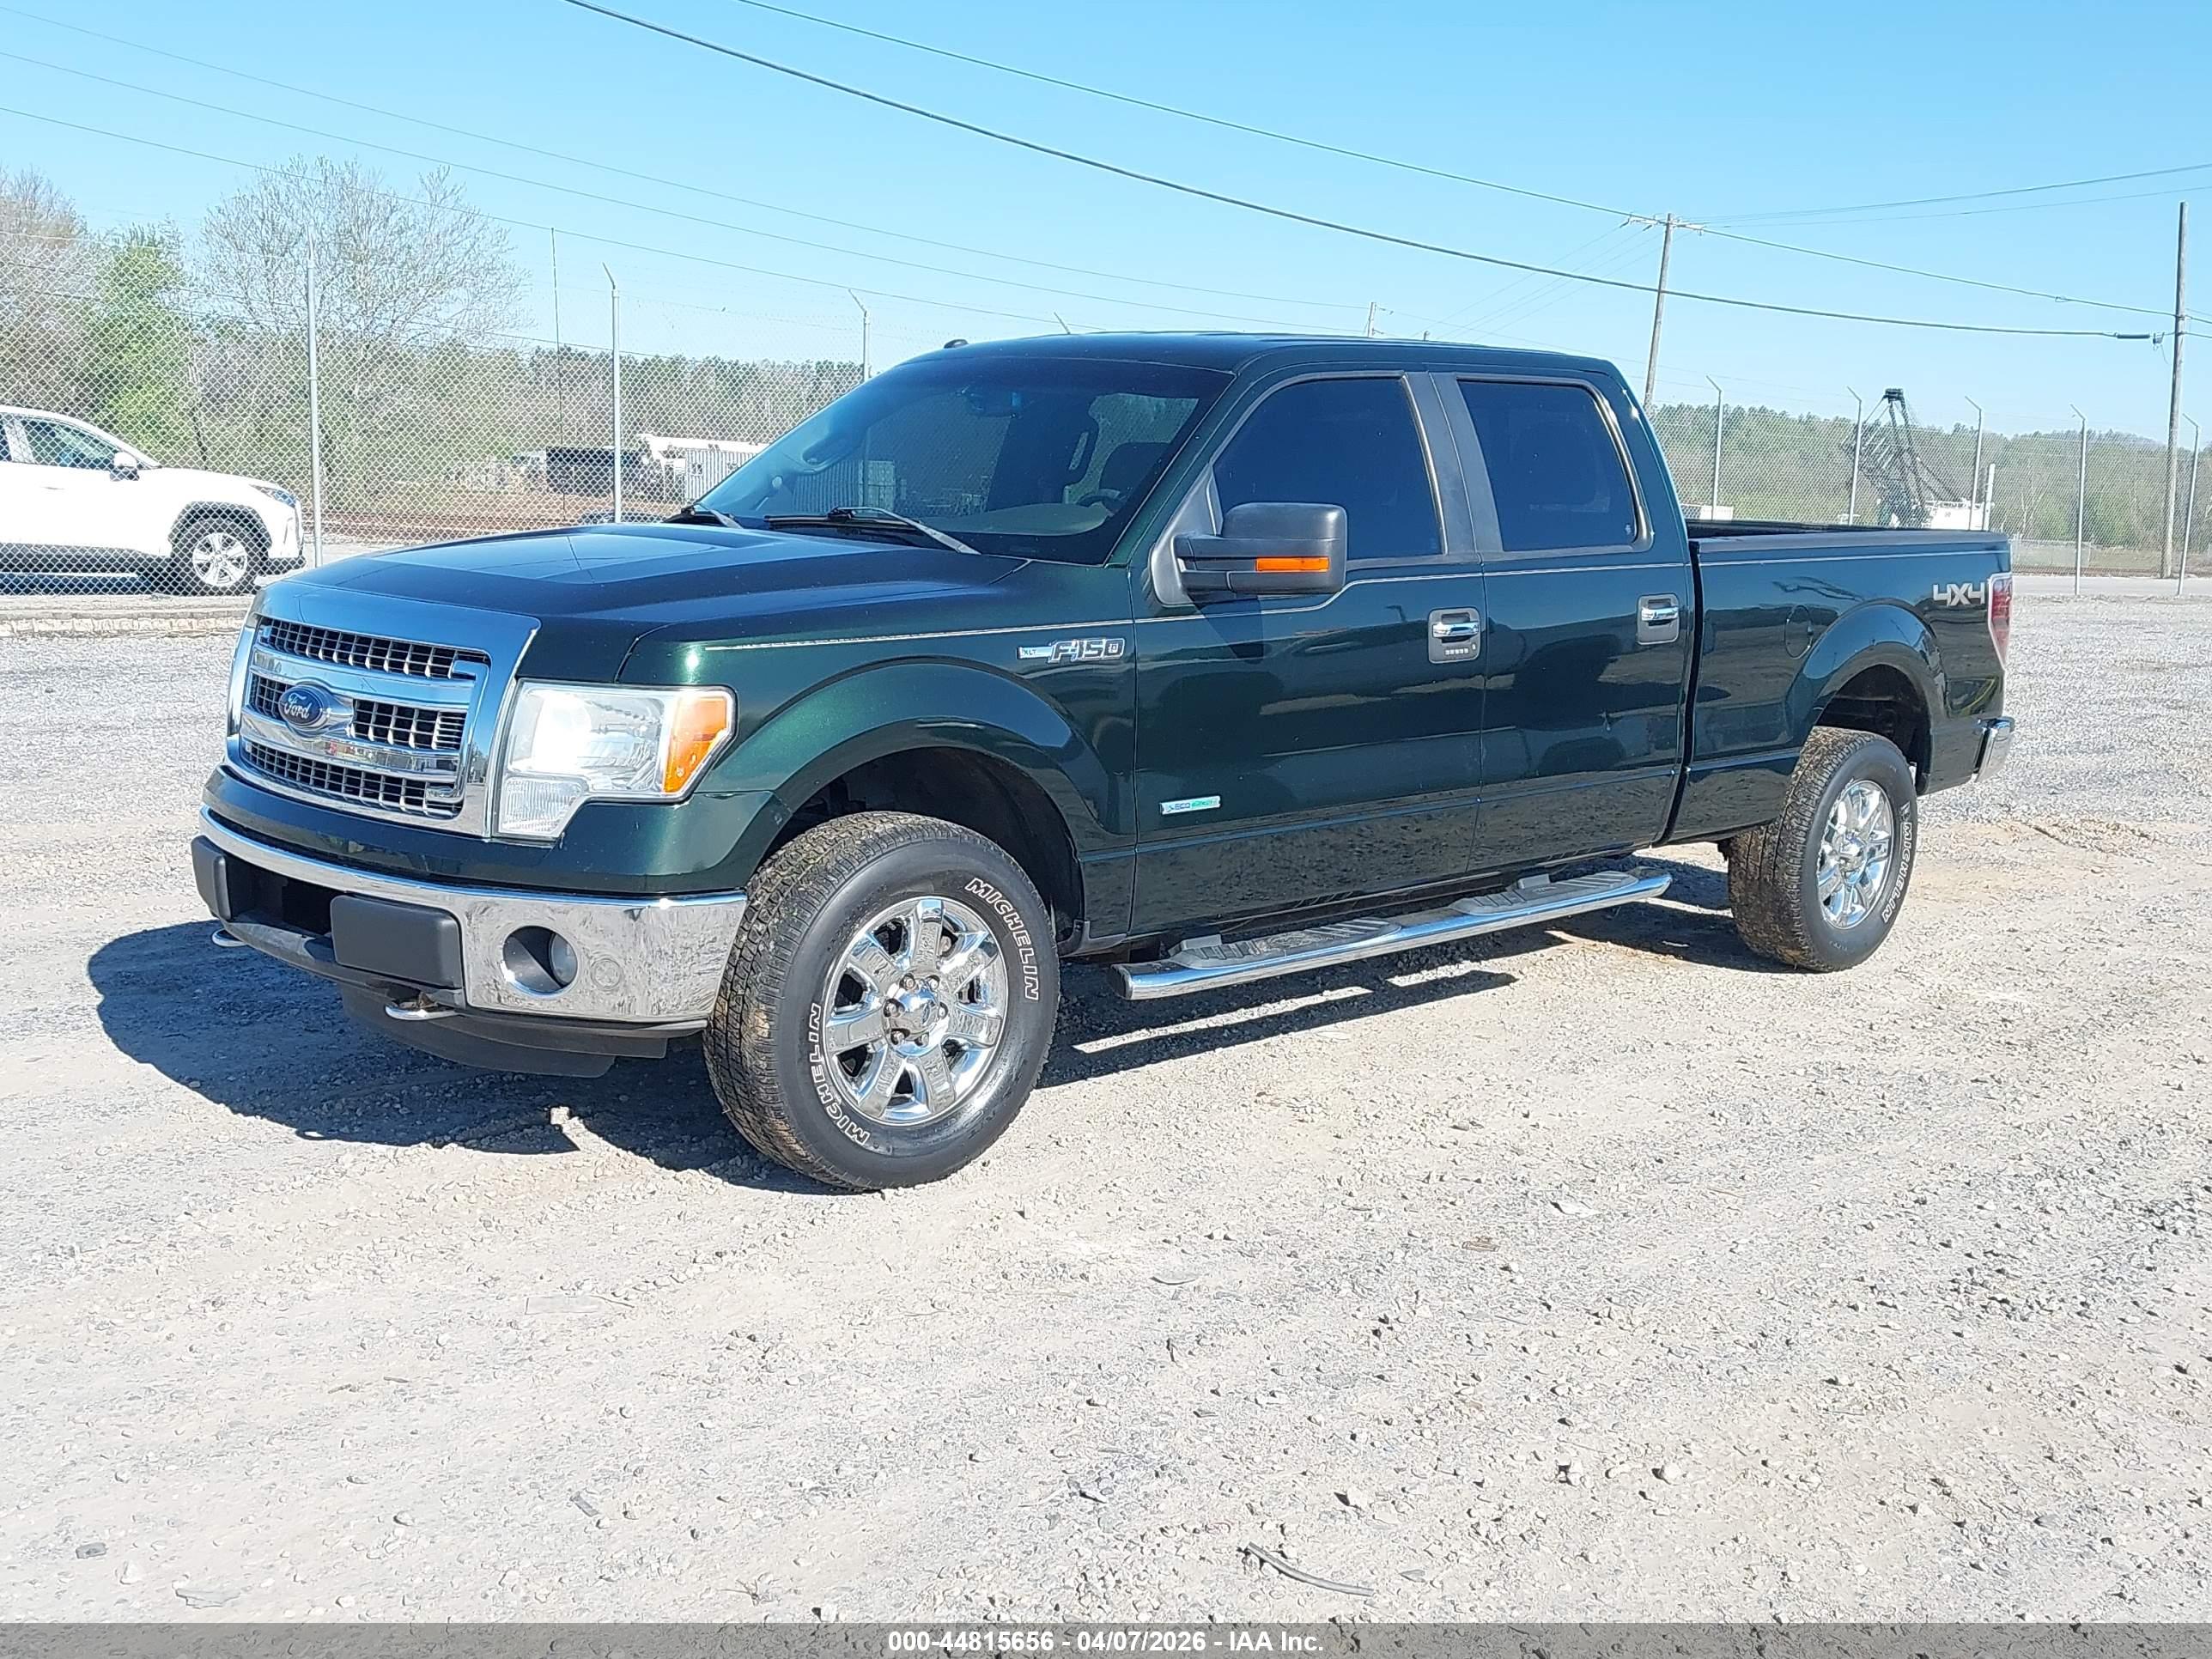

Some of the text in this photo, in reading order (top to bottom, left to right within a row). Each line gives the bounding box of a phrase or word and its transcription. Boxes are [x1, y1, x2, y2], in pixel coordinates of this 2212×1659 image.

[1933, 582, 1985, 606] 4X4
[283, 692, 313, 720] Ford
[1881, 822, 1911, 923] MICHELIN
[965, 877, 1041, 1000] MICHELIN
[809, 1002, 871, 1146] MICHELIN
